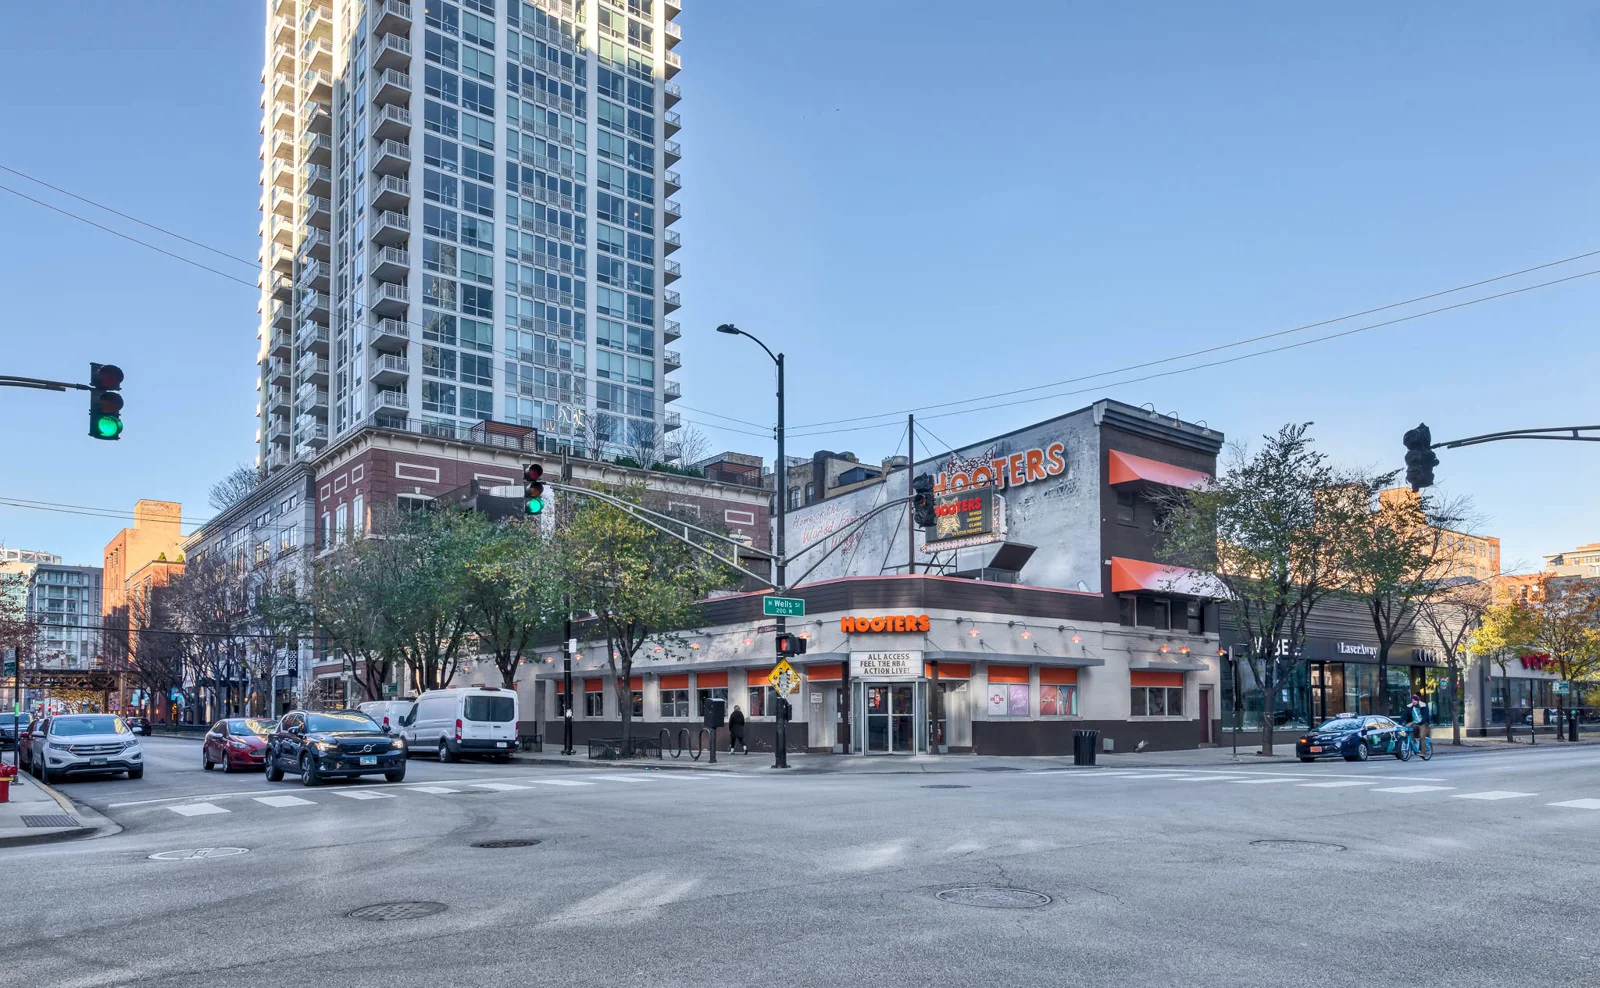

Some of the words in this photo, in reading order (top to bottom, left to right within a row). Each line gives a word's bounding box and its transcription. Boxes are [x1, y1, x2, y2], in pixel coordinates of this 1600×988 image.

[933, 441, 1065, 495] HOOTERS
[774, 600, 792, 608] Wells
[840, 614, 931, 633] HOOTERS
[1340, 642, 1378, 659] LaserAway
